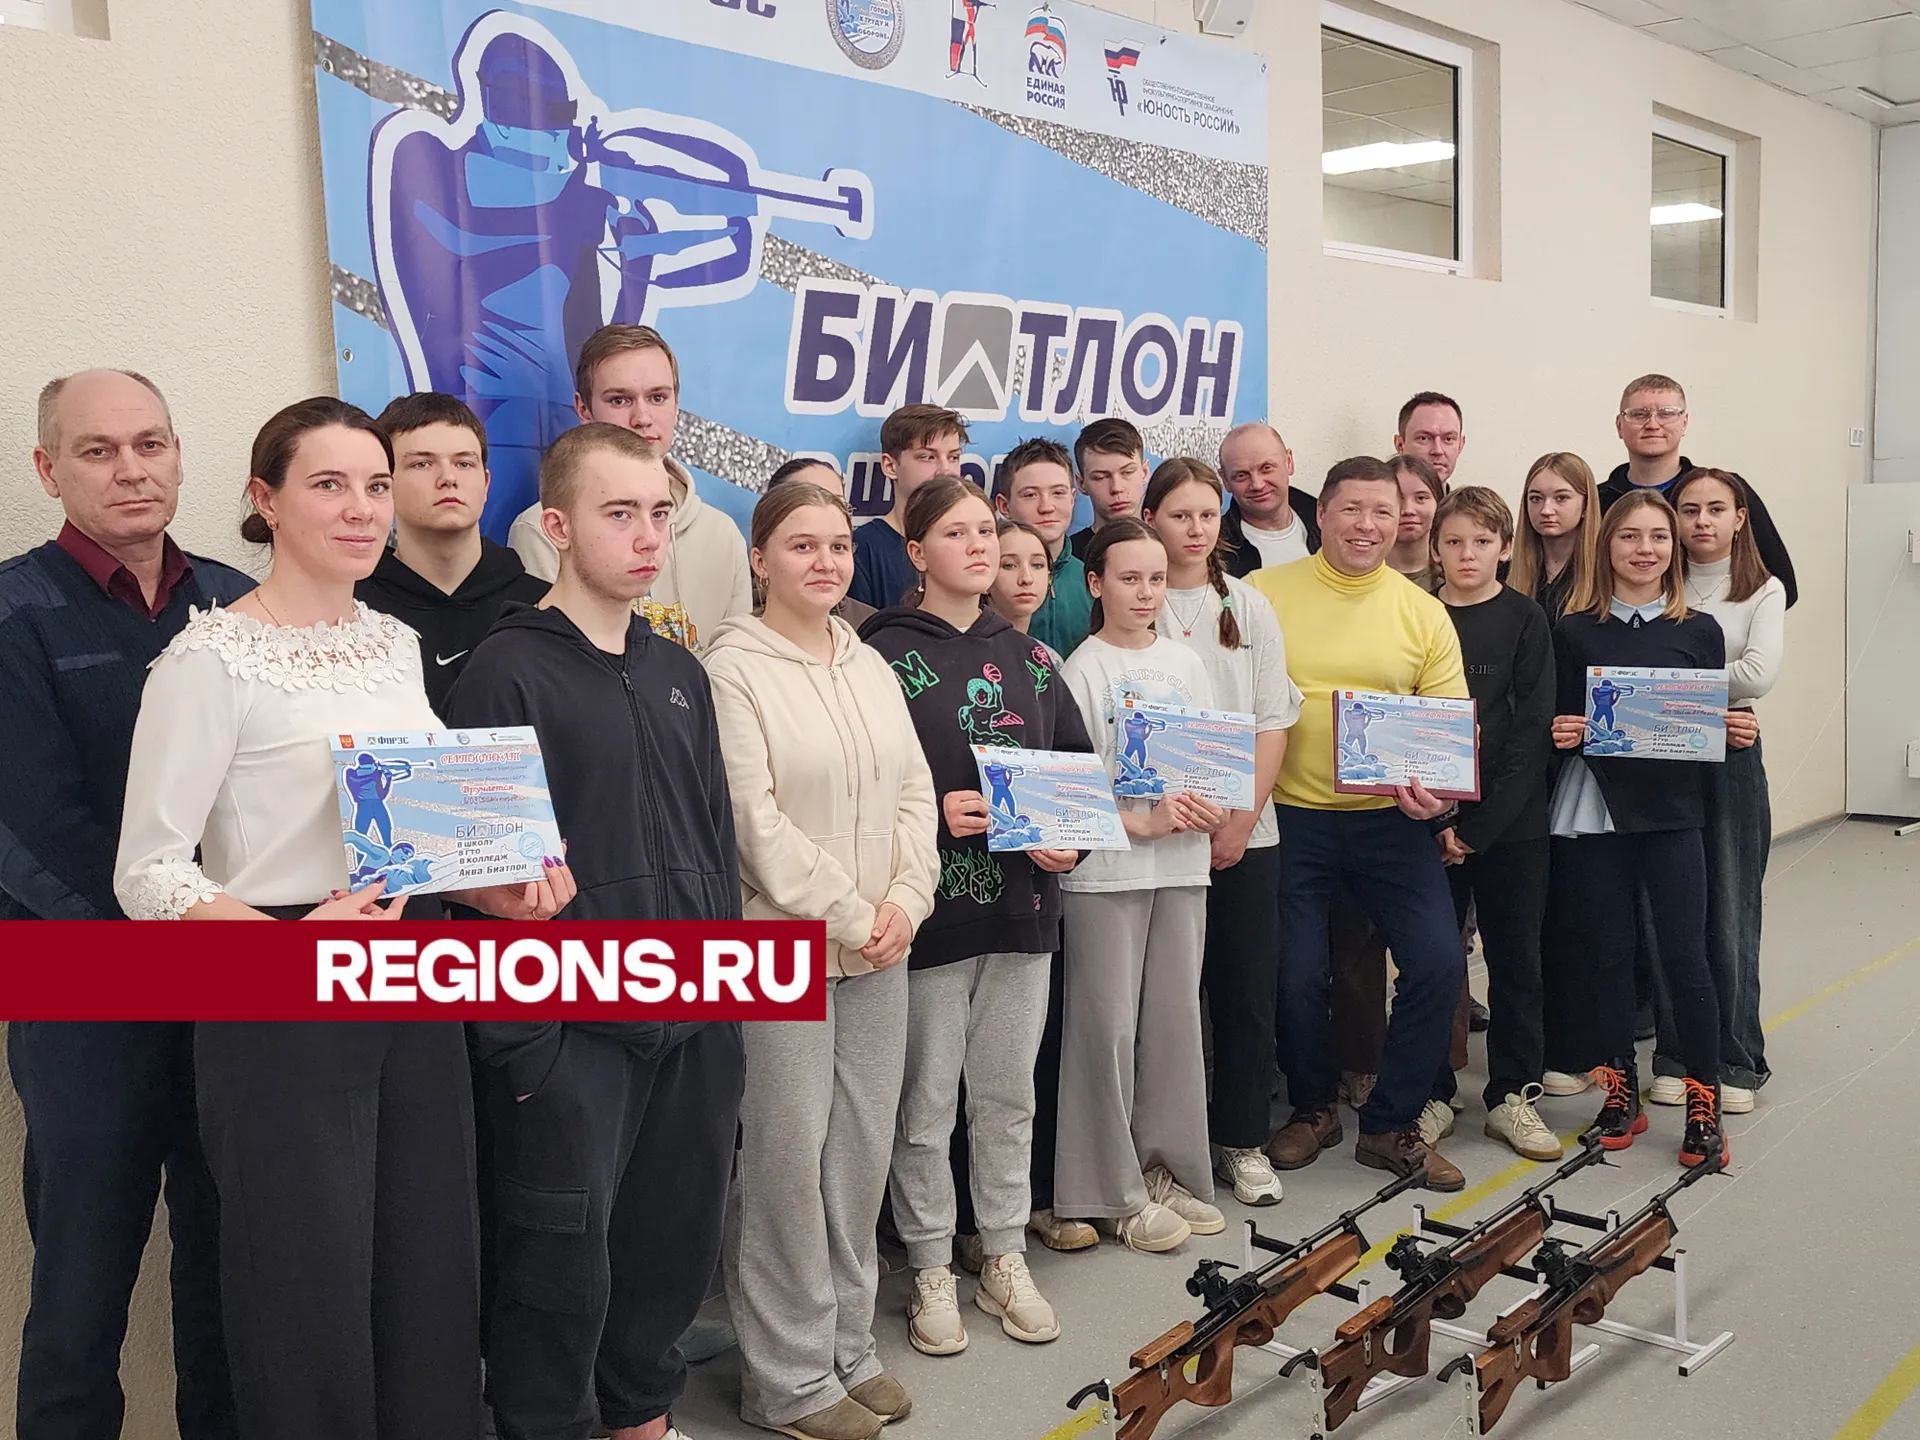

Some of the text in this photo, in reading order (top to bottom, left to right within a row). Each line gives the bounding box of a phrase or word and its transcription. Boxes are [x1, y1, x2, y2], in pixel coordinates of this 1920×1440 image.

[870, 6, 889, 15] ГОТОВ
[865, 18, 883, 26] ТРУДУ
[1026, 77, 1065, 95] ЕДИНАЯ
[1026, 91, 1065, 110] РОССИЯ
[1137, 99, 1240, 135] «ЮНОСТЬ РОССИИ»
[889, 650, 940, 699] M
[464, 839, 494, 848] ШКОЛУ
[466, 854, 508, 864] КОЛЛЕДЖ
[459, 864, 527, 877] Аква Биатлон
